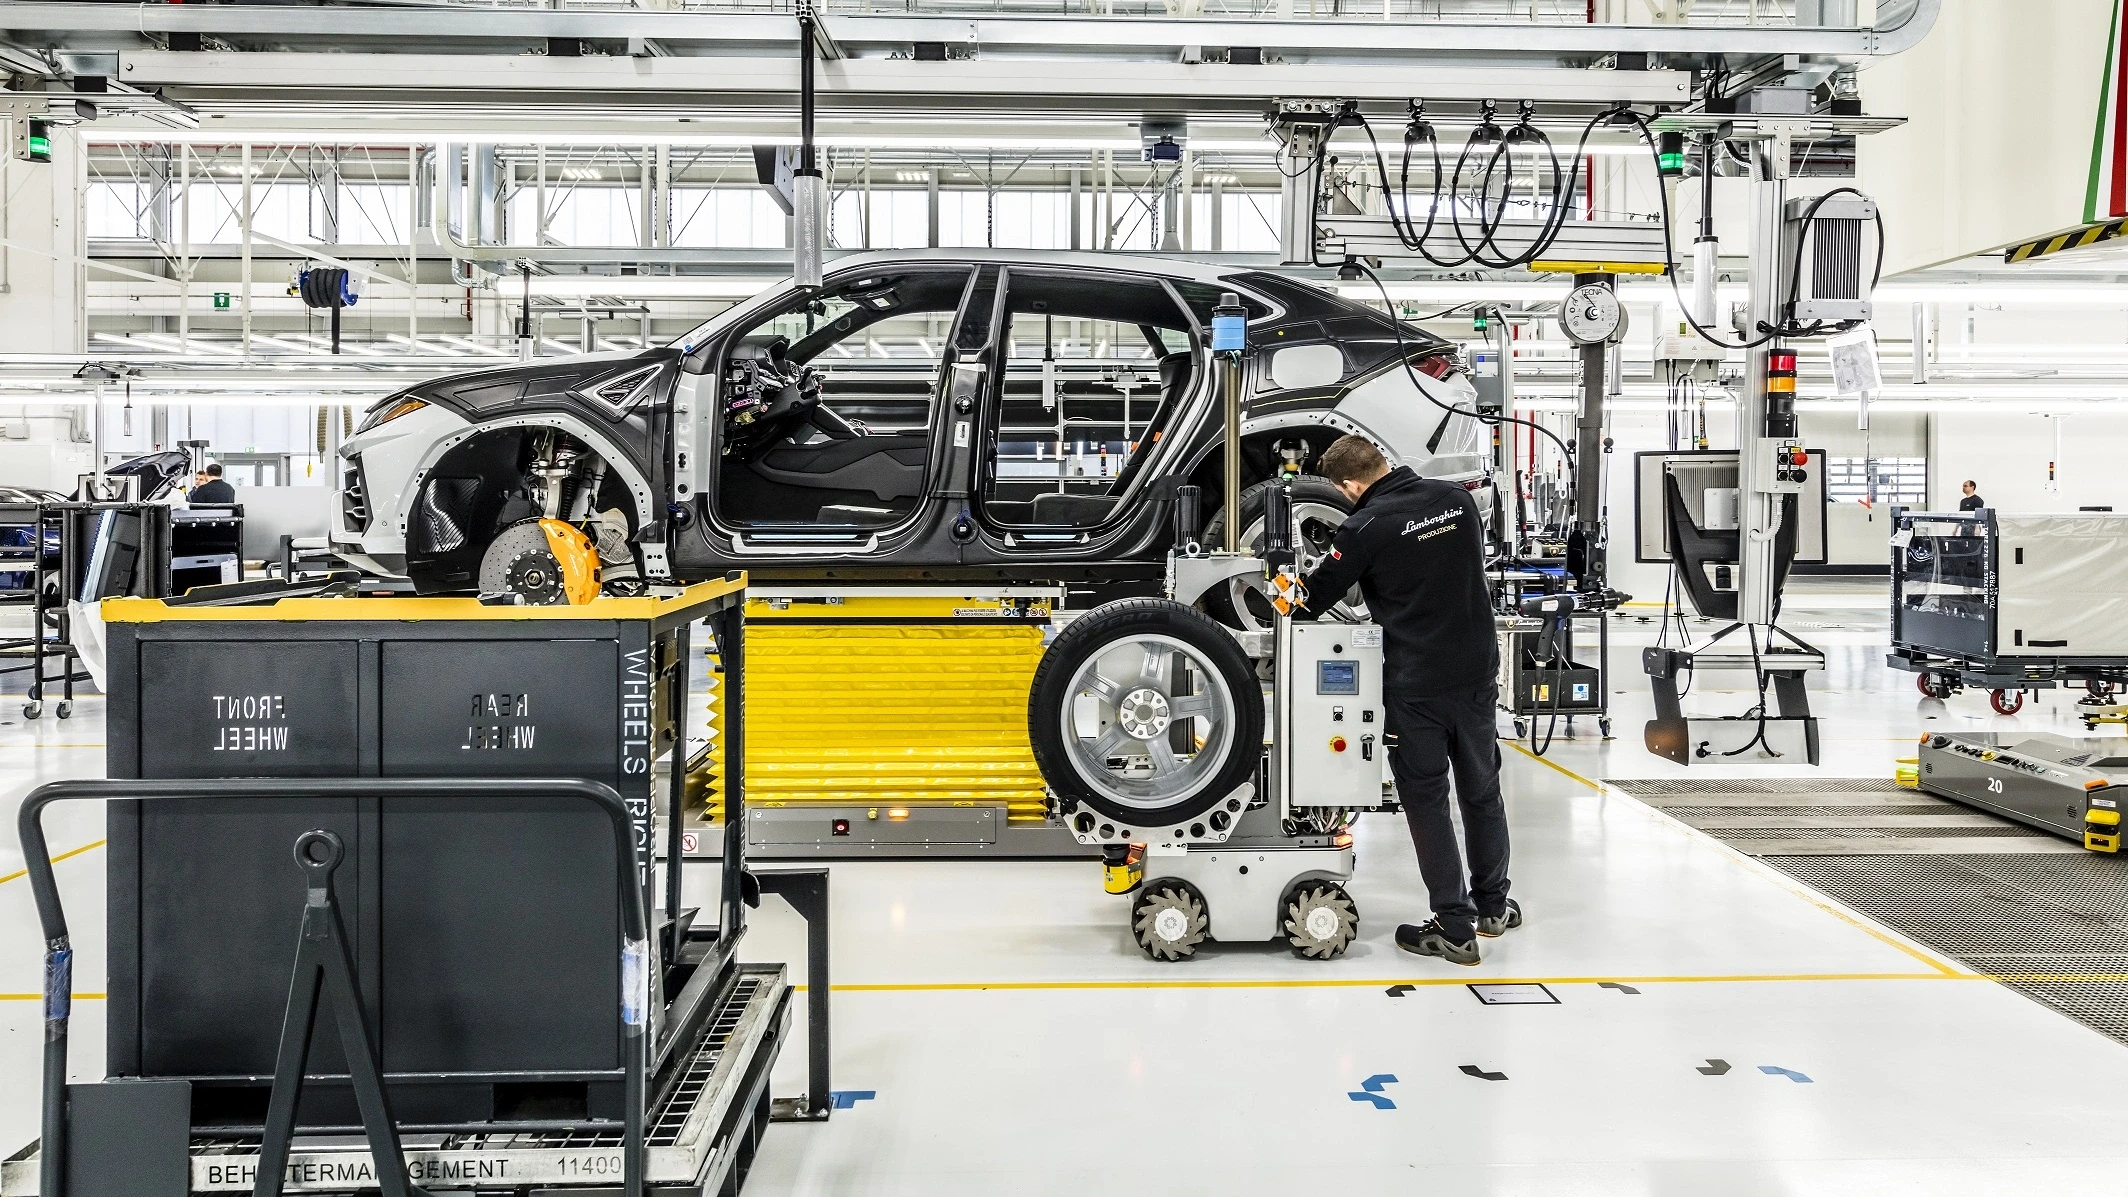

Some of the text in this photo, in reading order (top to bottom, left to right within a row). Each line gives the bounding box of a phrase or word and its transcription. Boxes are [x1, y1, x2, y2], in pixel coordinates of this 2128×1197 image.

[1401, 507, 1463, 536] Lamborghini
[1417, 523, 1457, 541] PRODUZIONE
[624, 649, 648, 774] WHEELS
[1987, 777, 2003, 794] 20
[208, 1159, 509, 1185] BEHTERMAGEMENT
